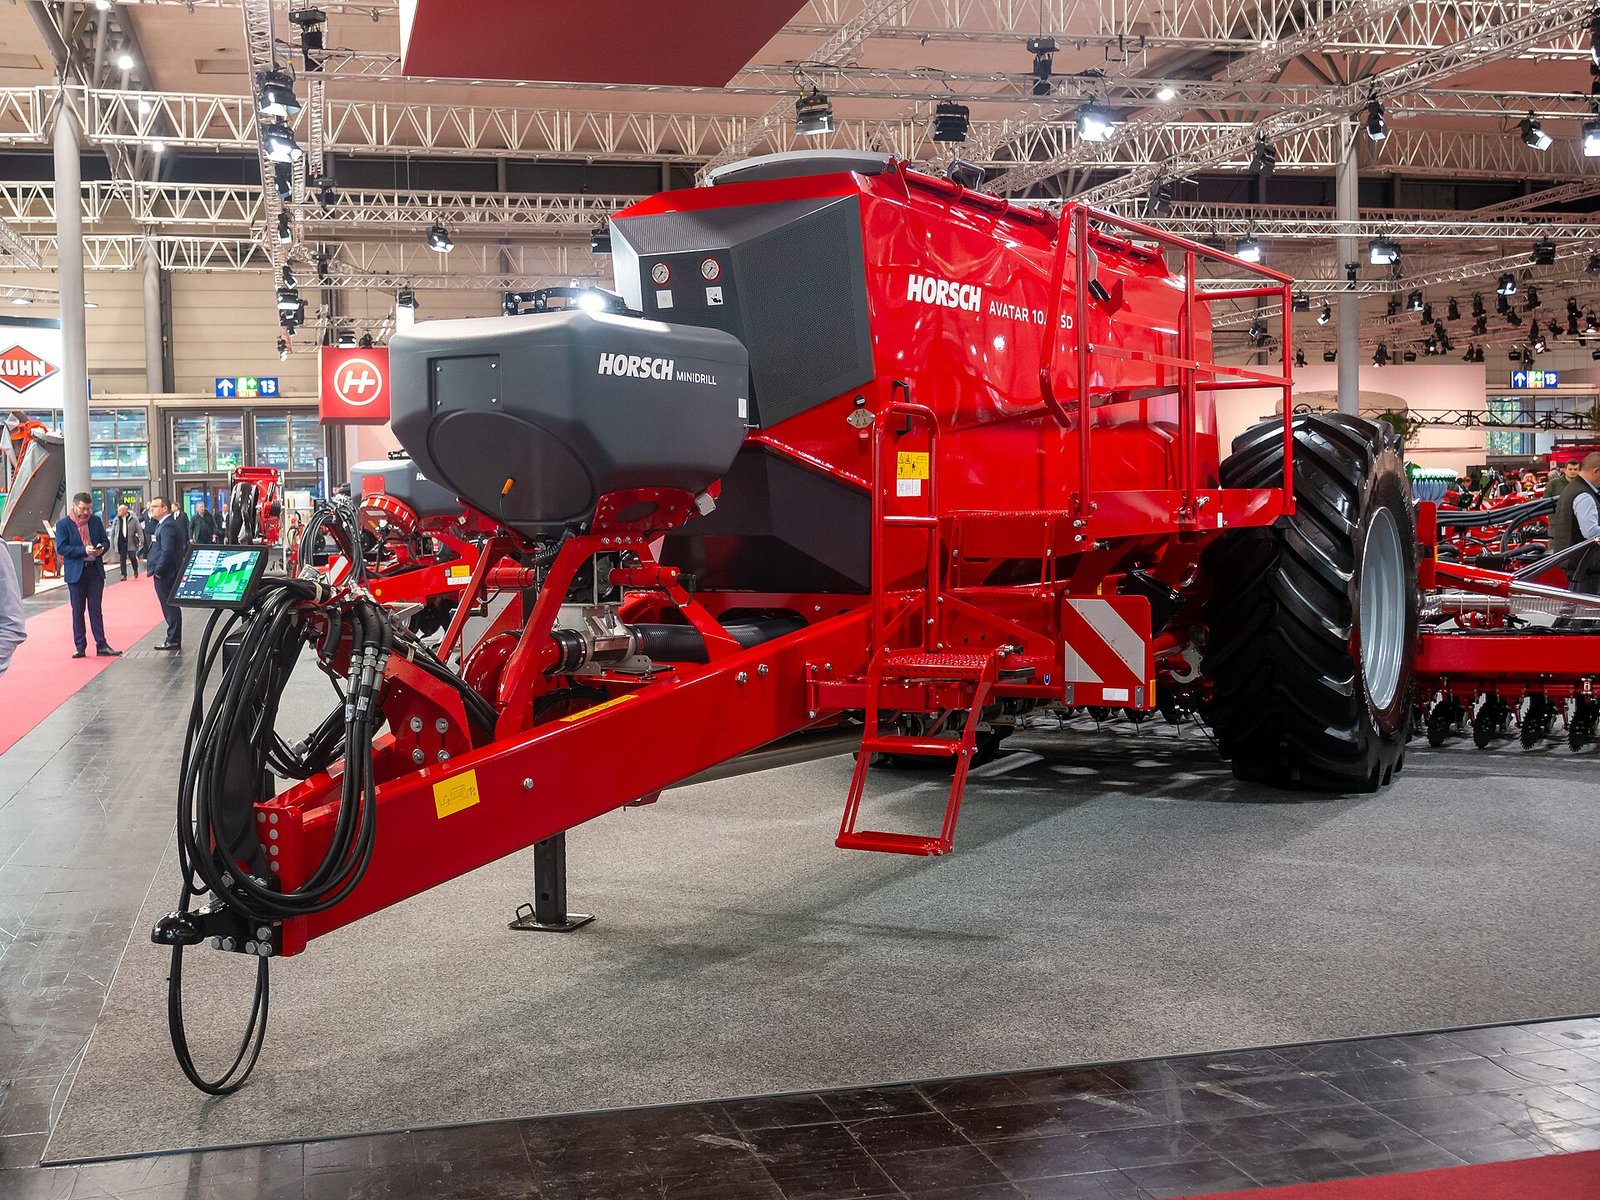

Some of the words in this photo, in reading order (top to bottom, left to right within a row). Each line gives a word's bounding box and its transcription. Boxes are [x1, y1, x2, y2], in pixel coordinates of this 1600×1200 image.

[907, 274, 982, 313] HORSCH
[989, 300, 1029, 323] AVATAR
[1032, 309, 1047, 326] 10.
[1060, 314, 1073, 330] SD
[598, 352, 675, 381] HORSCH
[676, 370, 717, 386] MINIDRILL
[1544, 373, 1556, 385] 13
[260, 379, 276, 394] 13
